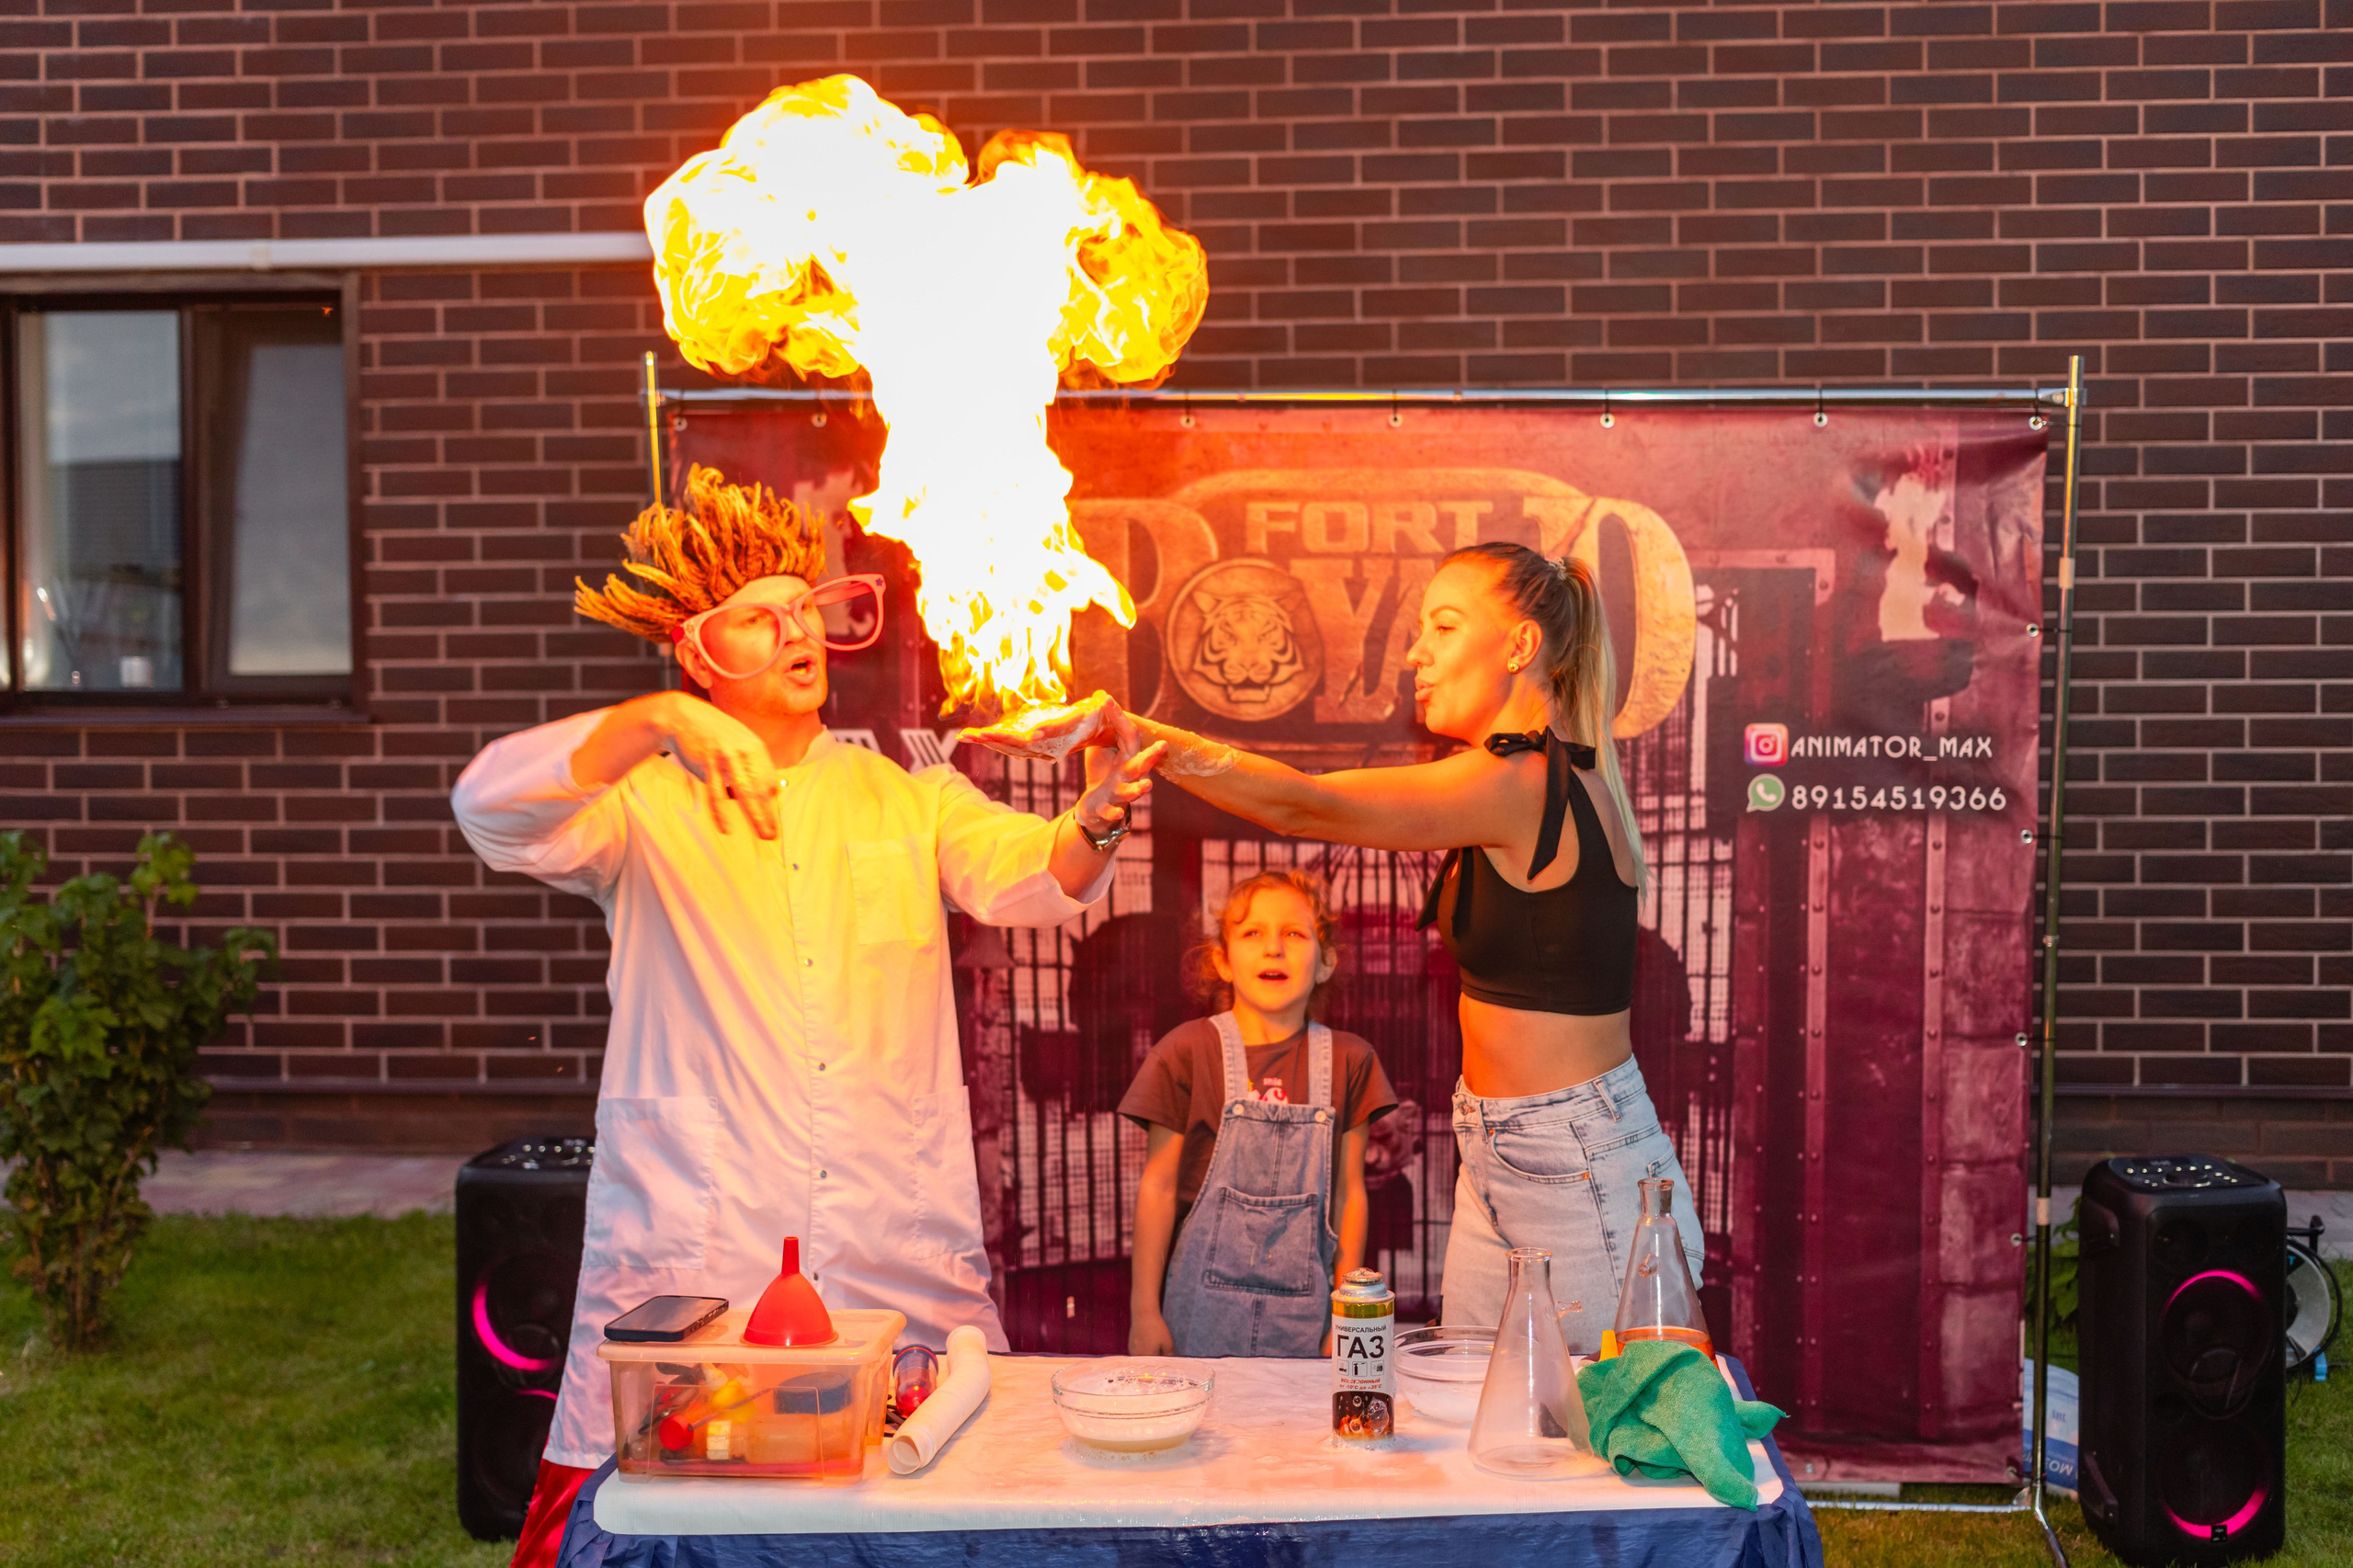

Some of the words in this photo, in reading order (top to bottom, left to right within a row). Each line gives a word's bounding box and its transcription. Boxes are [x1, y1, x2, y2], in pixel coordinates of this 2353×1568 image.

[1245, 501, 1494, 553] FORT
[1790, 735, 1994, 762] ANIMATOR_MAX
[1791, 785, 2007, 811] 89154519366
[1263, 1077, 1283, 1086] smile
[1336, 1324, 1387, 1333] УНИВЕРСАЛЬНЫЙ
[1337, 1335, 1384, 1359] ГАЗ
